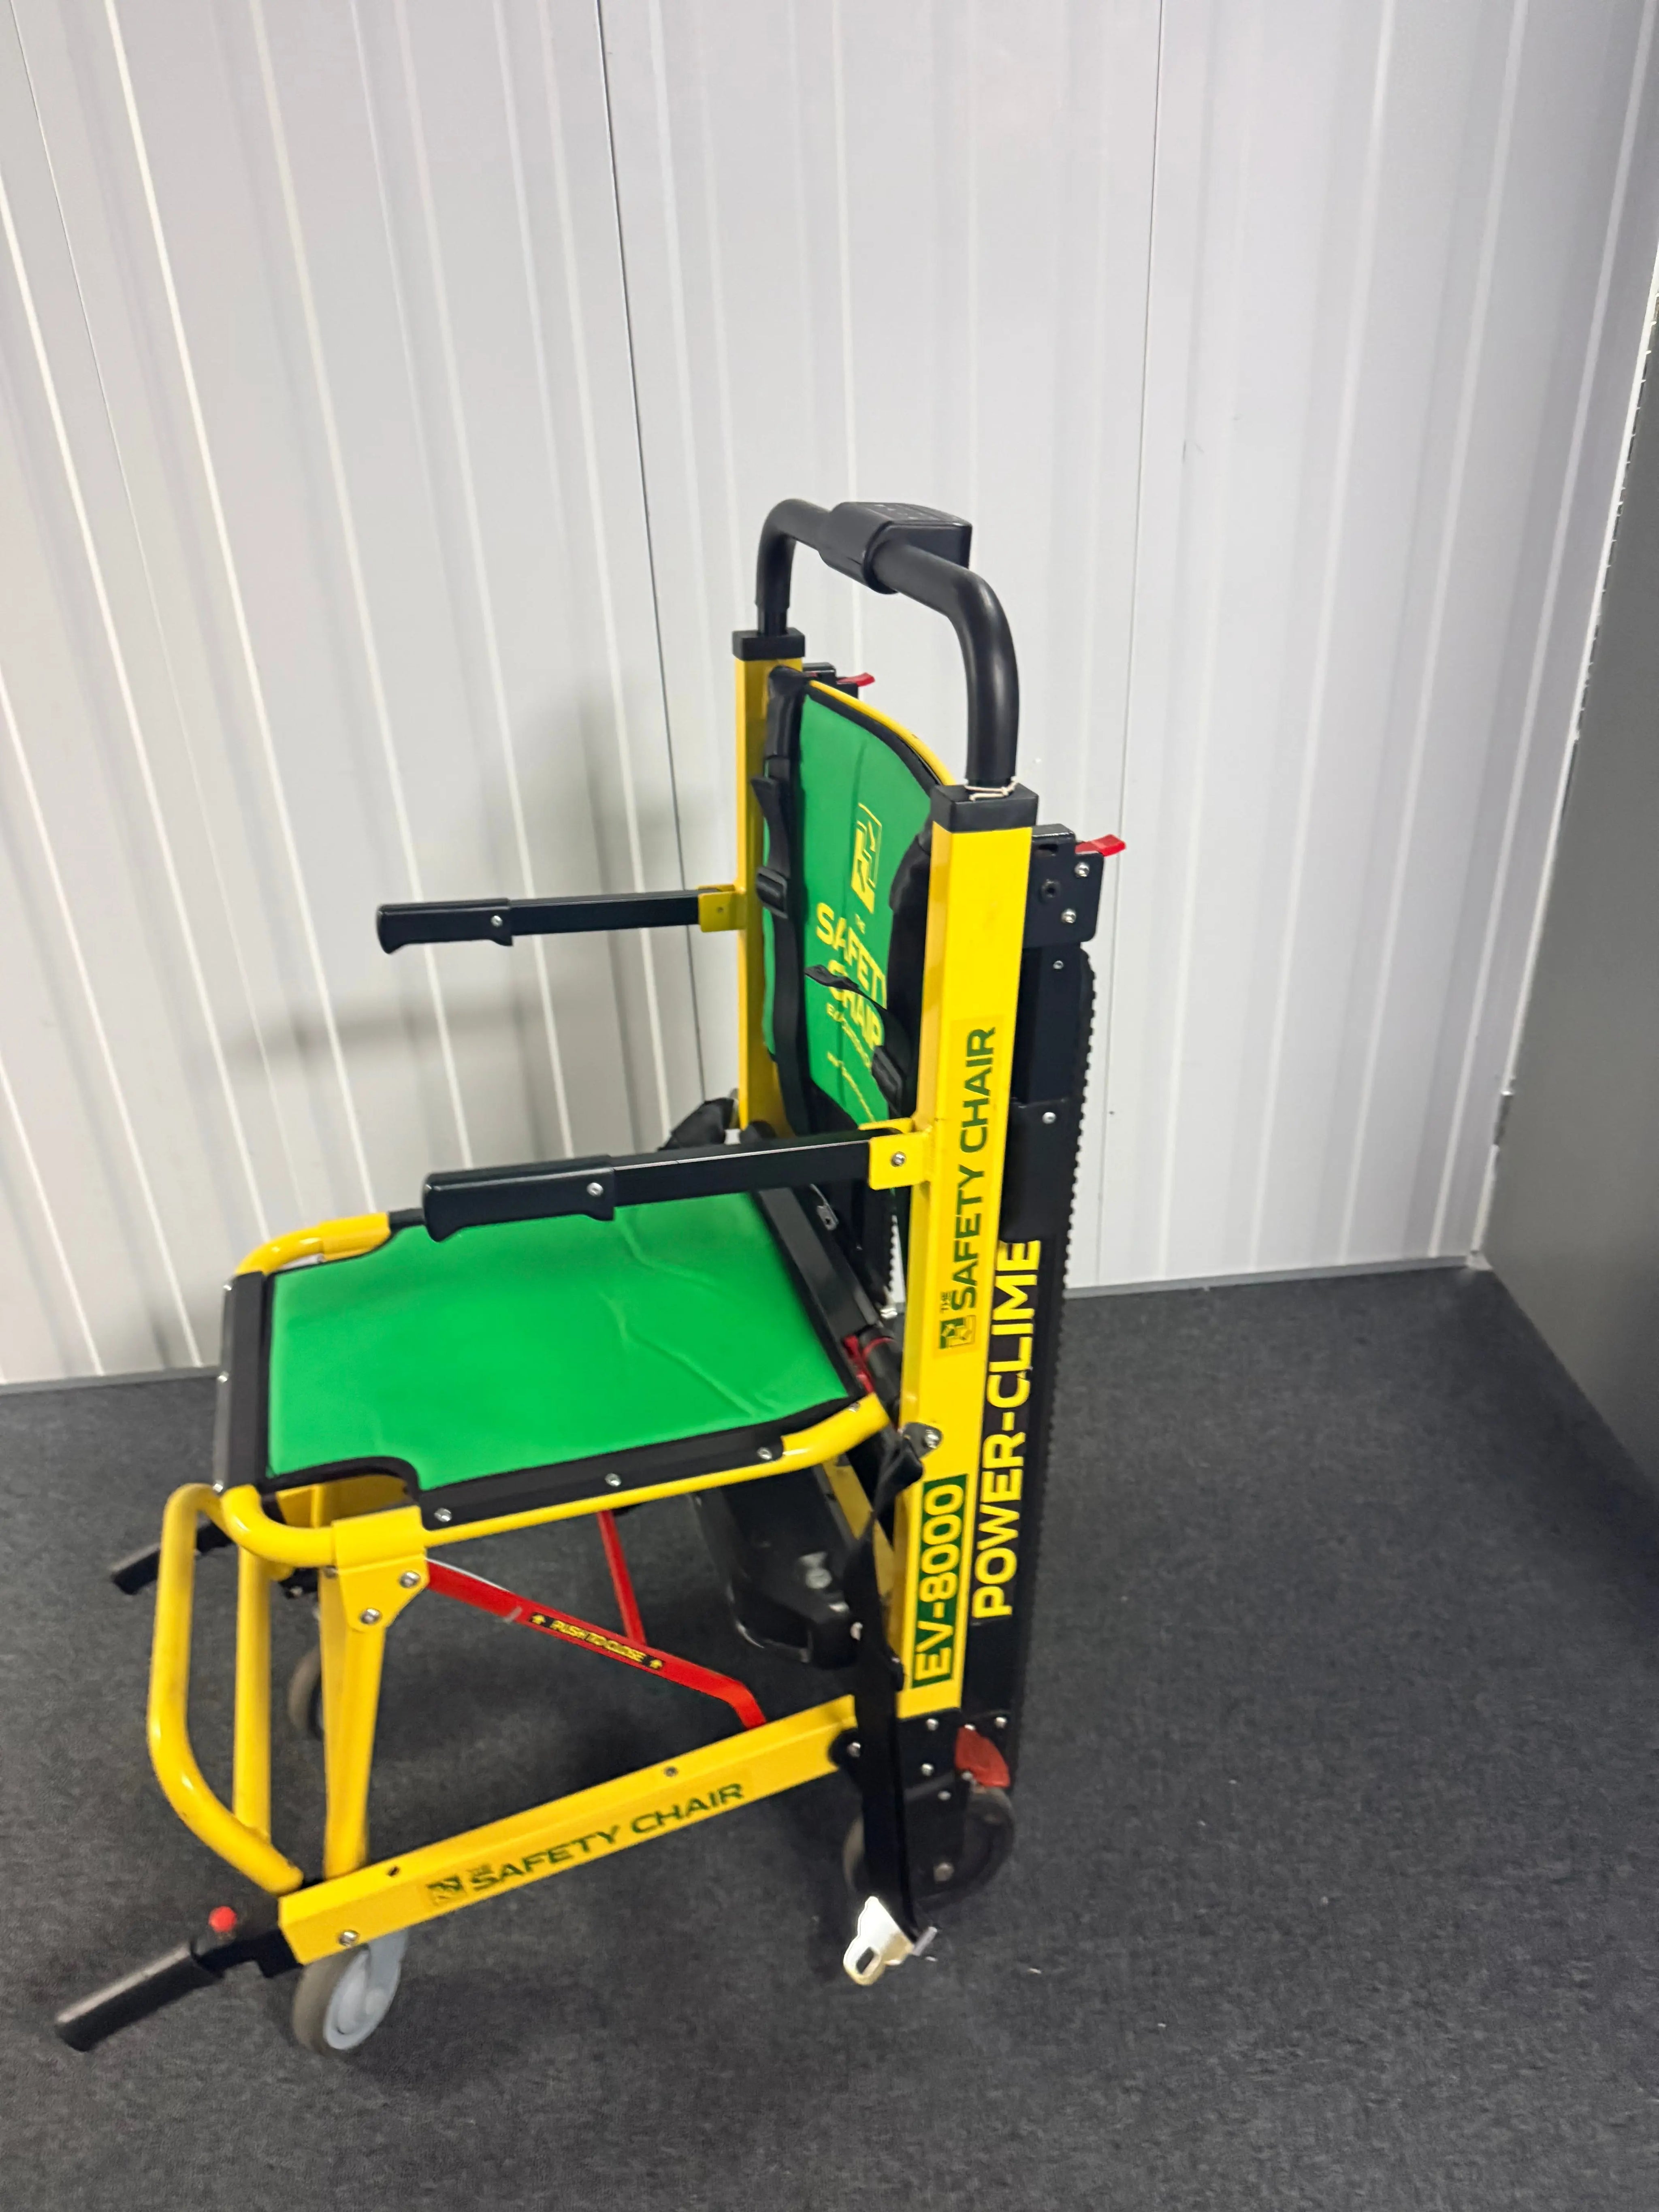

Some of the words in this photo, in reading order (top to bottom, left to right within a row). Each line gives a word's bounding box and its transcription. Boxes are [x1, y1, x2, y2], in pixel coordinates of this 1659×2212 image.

[960, 1026, 996, 1153] CHAIR
[951, 1164, 984, 1311] SAFETY
[914, 1484, 964, 1680] EV-8000
[471, 1826, 619, 1891] SAFETY
[631, 1783, 744, 1833] CHAIR
